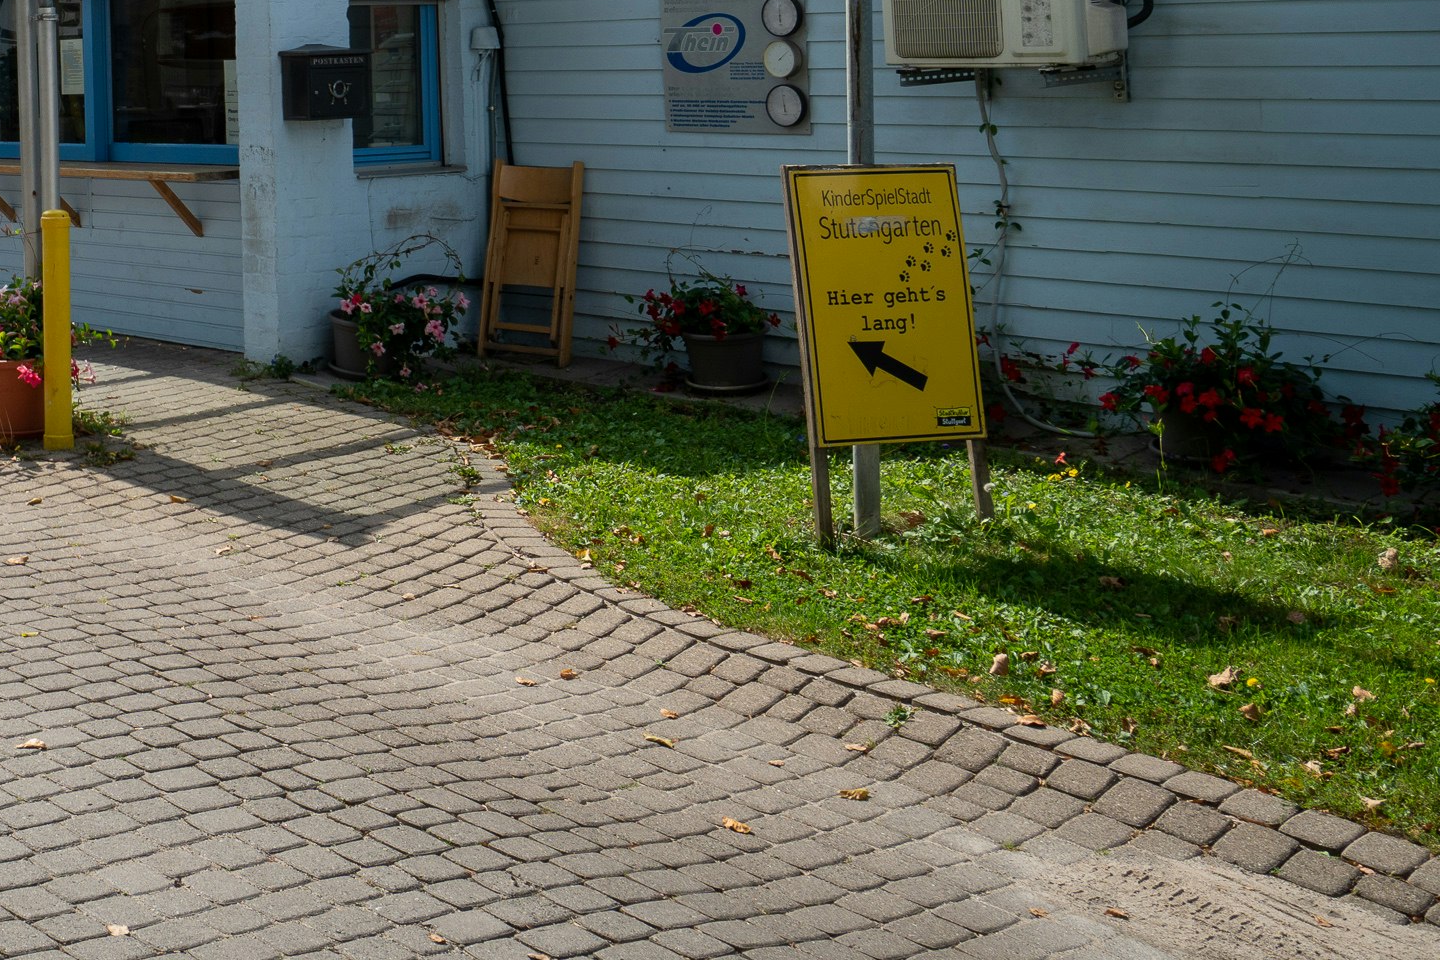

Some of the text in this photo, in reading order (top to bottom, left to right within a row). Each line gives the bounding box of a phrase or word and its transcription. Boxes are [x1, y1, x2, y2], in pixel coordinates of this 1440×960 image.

[664, 23, 735, 53] Thein
[822, 188, 932, 209] KinderSpielStadt
[819, 216, 942, 244] Stutengarten
[827, 290, 874, 305] Hier
[862, 313, 917, 334] lang!
